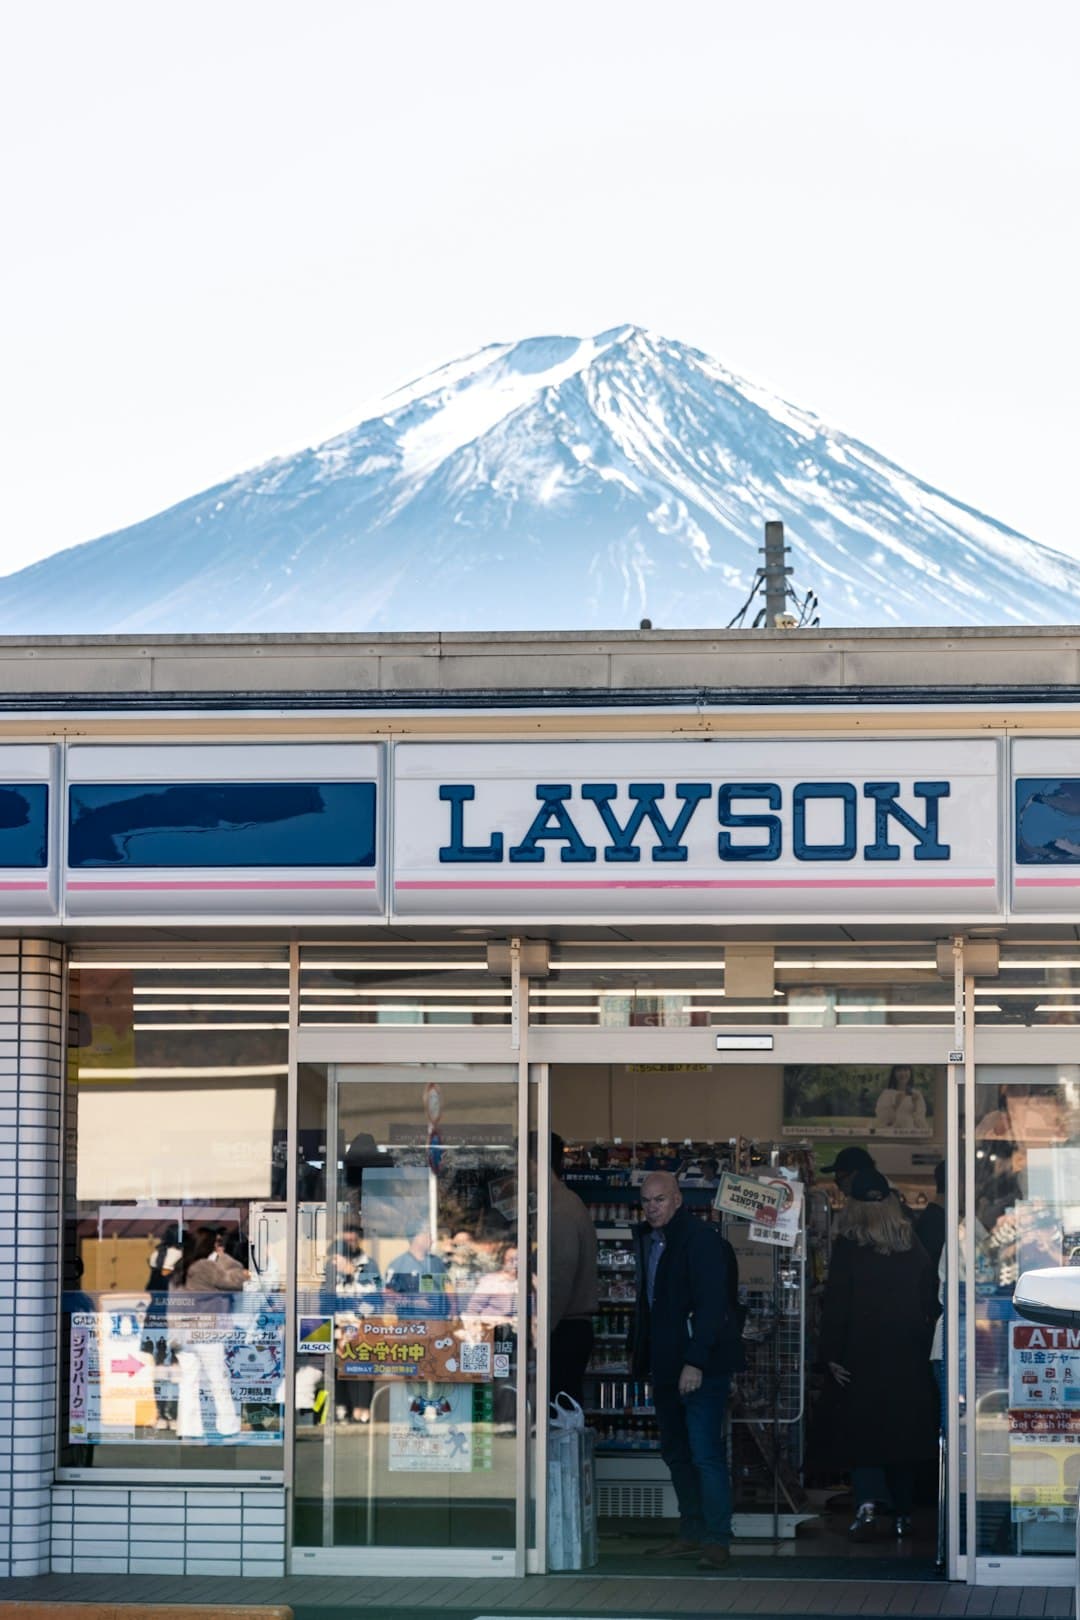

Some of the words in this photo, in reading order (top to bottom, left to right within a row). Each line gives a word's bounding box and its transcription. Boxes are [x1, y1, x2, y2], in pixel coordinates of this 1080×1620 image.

[439, 782, 951, 863] LAWSON
[761, 1194, 777, 1205] ALL
[300, 1343, 331, 1351] ALSOK
[1028, 1328, 1080, 1349] ATM
[343, 1342, 425, 1361] 入会受付中
[72, 1335, 86, 1409] ジブリパーク
[1011, 1420, 1028, 1429] Get
[1031, 1420, 1055, 1429] Cash
